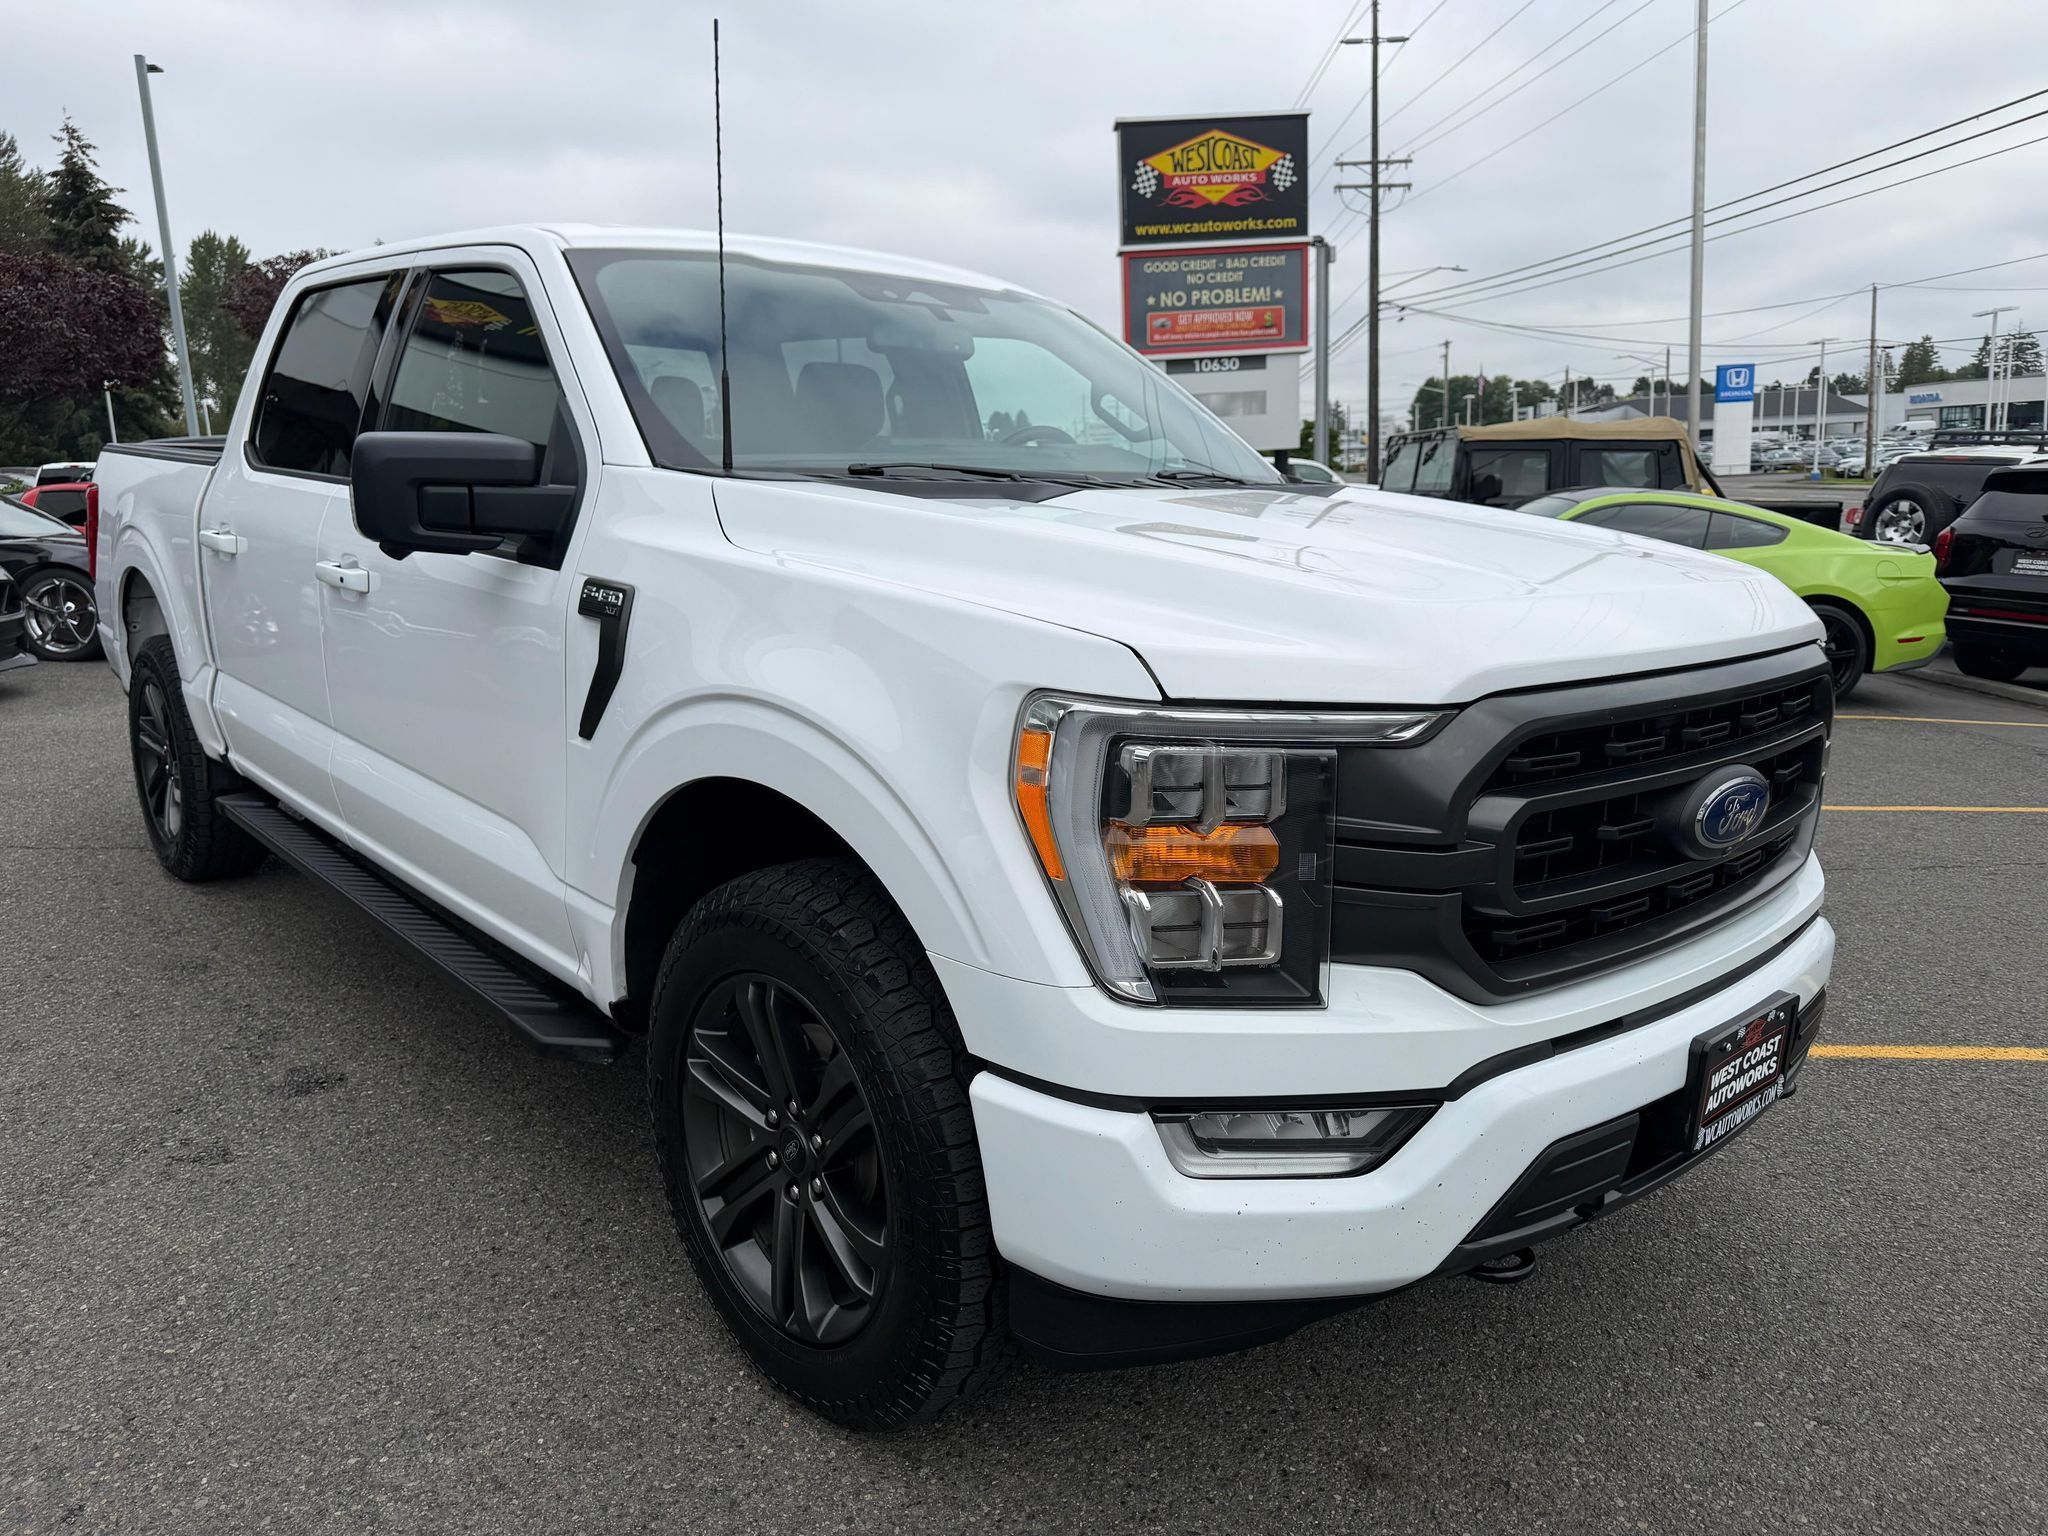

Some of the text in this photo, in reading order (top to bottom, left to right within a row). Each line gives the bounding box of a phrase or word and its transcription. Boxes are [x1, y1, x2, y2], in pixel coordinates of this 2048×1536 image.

[1172, 172, 1257, 186] AUTO WORKS
[1135, 217, 1297, 236] www.wcautoworks.com
[1144, 261, 1180, 273] GOOD
[1181, 259, 1217, 271] CREDIT
[1226, 257, 1248, 269] BAD
[1250, 255, 1286, 267] CREDIT
[1187, 271, 1244, 285] NO CREDIT
[1160, 286, 1270, 307] NO PROBLEM!
[1178, 311, 1254, 325] GET APPROVED NOW
[1193, 357, 1240, 373] 10630
[1719, 792, 1759, 835] Ford
[1710, 1034, 1782, 1091] WEST COAST
[1705, 1056, 1778, 1115] AUTOWORKS
[1704, 1083, 1778, 1147] WCAUTOWORKS.COM
